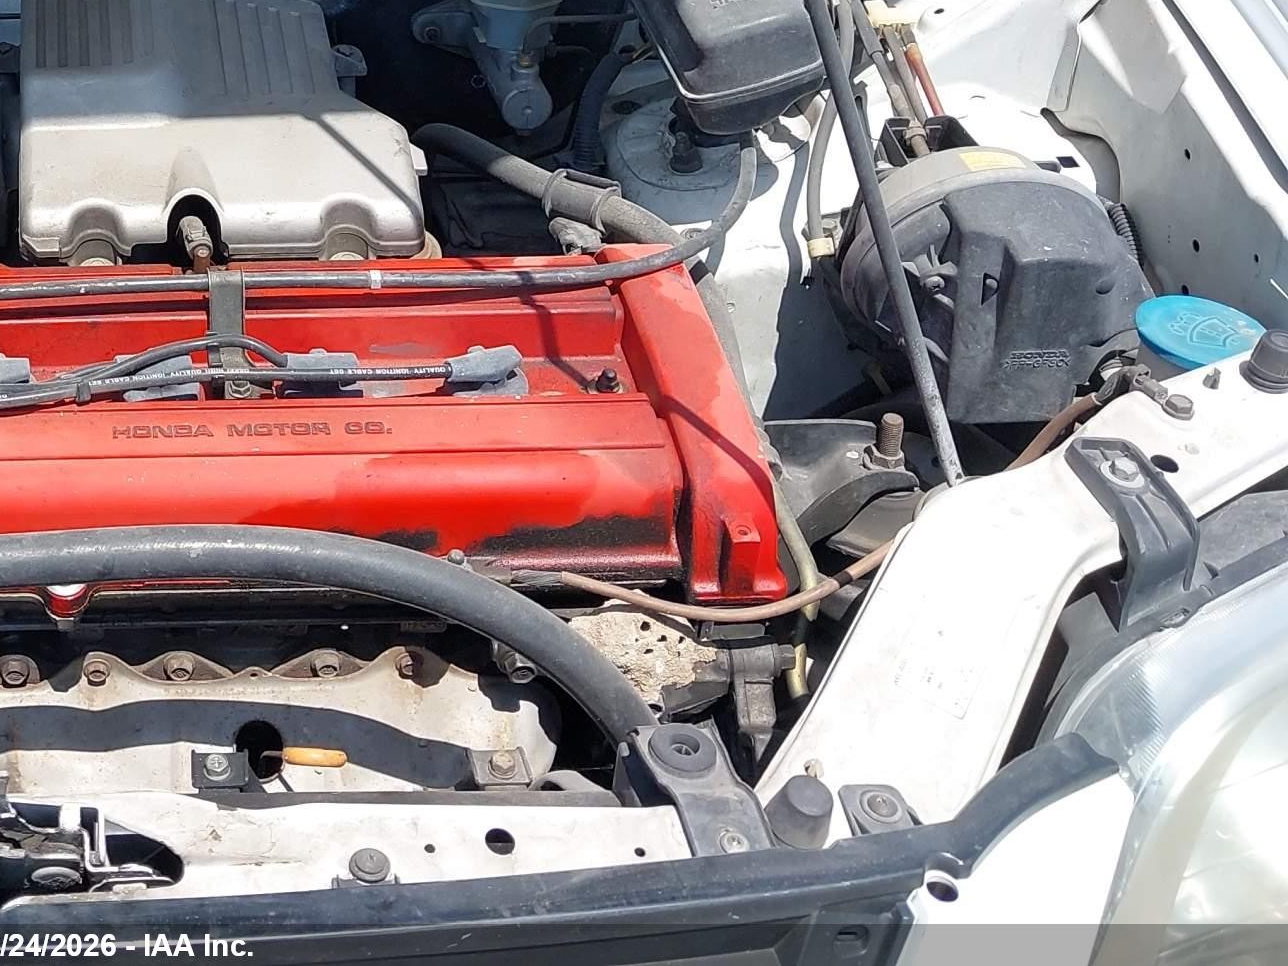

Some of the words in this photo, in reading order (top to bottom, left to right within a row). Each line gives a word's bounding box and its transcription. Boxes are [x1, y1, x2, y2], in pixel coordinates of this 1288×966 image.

[414, 366, 446, 375] QUALITY
[112, 424, 213, 439] HONDA
[226, 422, 331, 437] MOTOR
